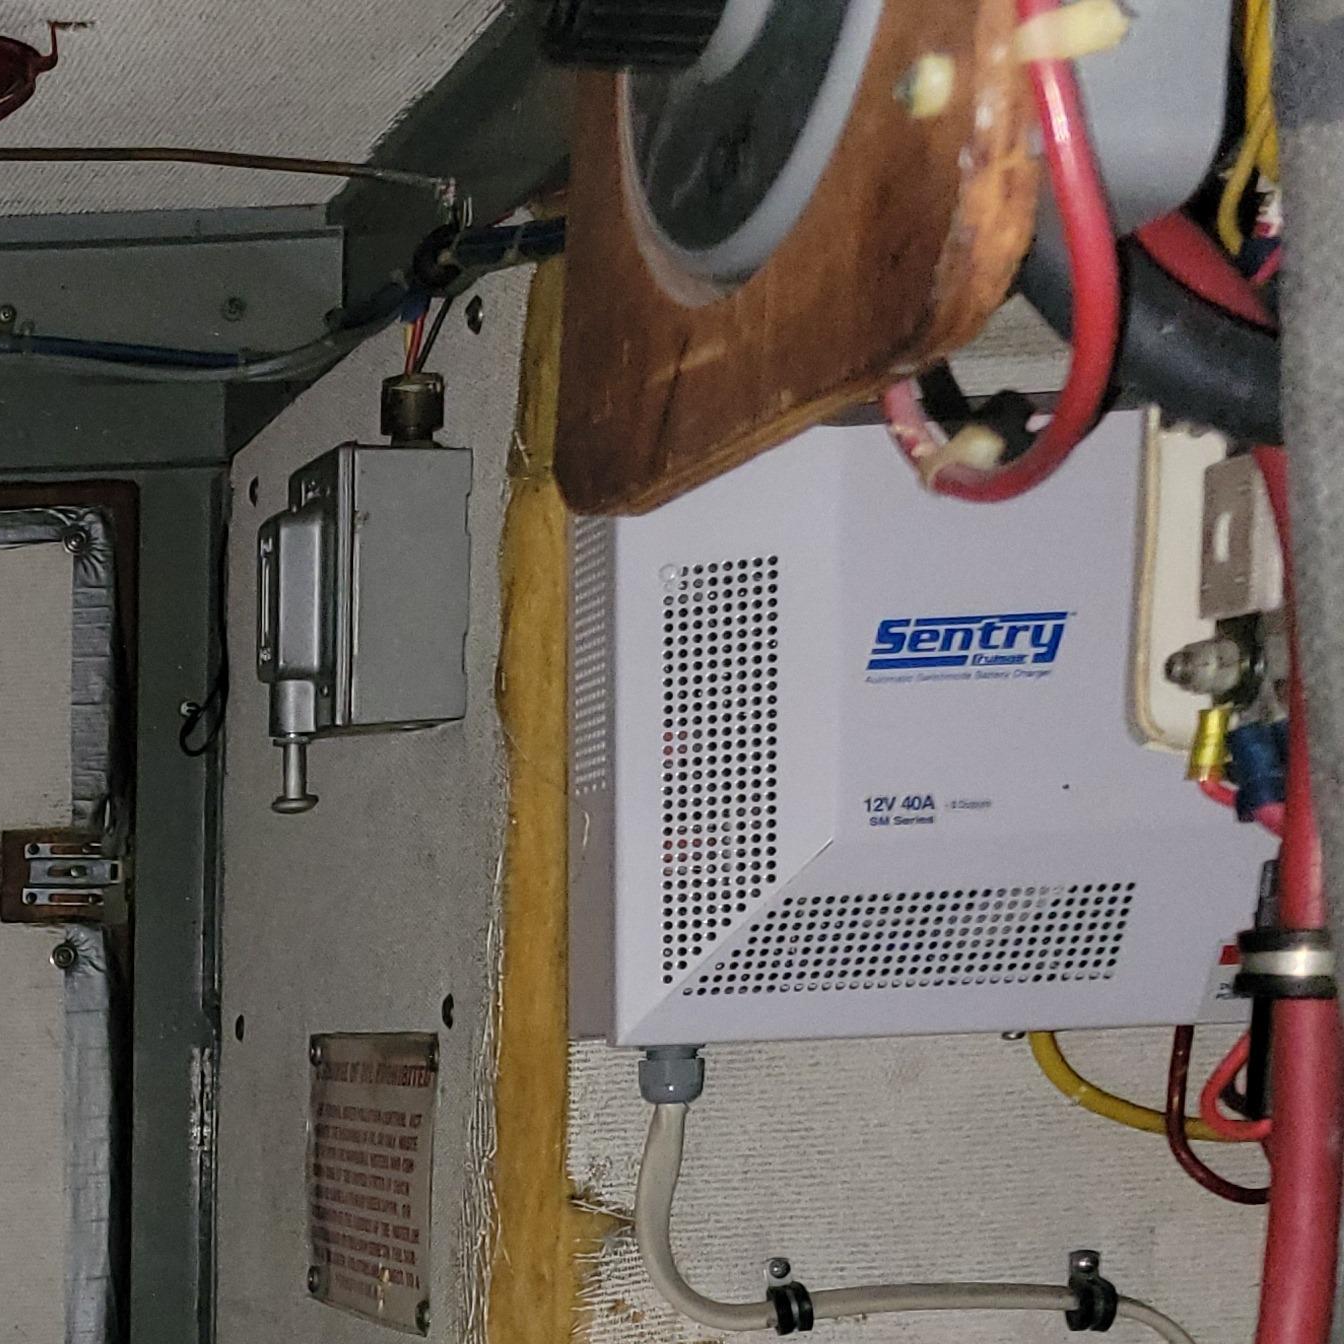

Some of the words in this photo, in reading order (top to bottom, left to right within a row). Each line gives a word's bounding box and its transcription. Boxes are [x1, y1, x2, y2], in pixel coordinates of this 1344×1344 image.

[868, 612, 1069, 669] Sentry
[864, 796, 896, 812] 12V
[902, 795, 935, 811] 40A
[893, 815, 934, 825] Series
